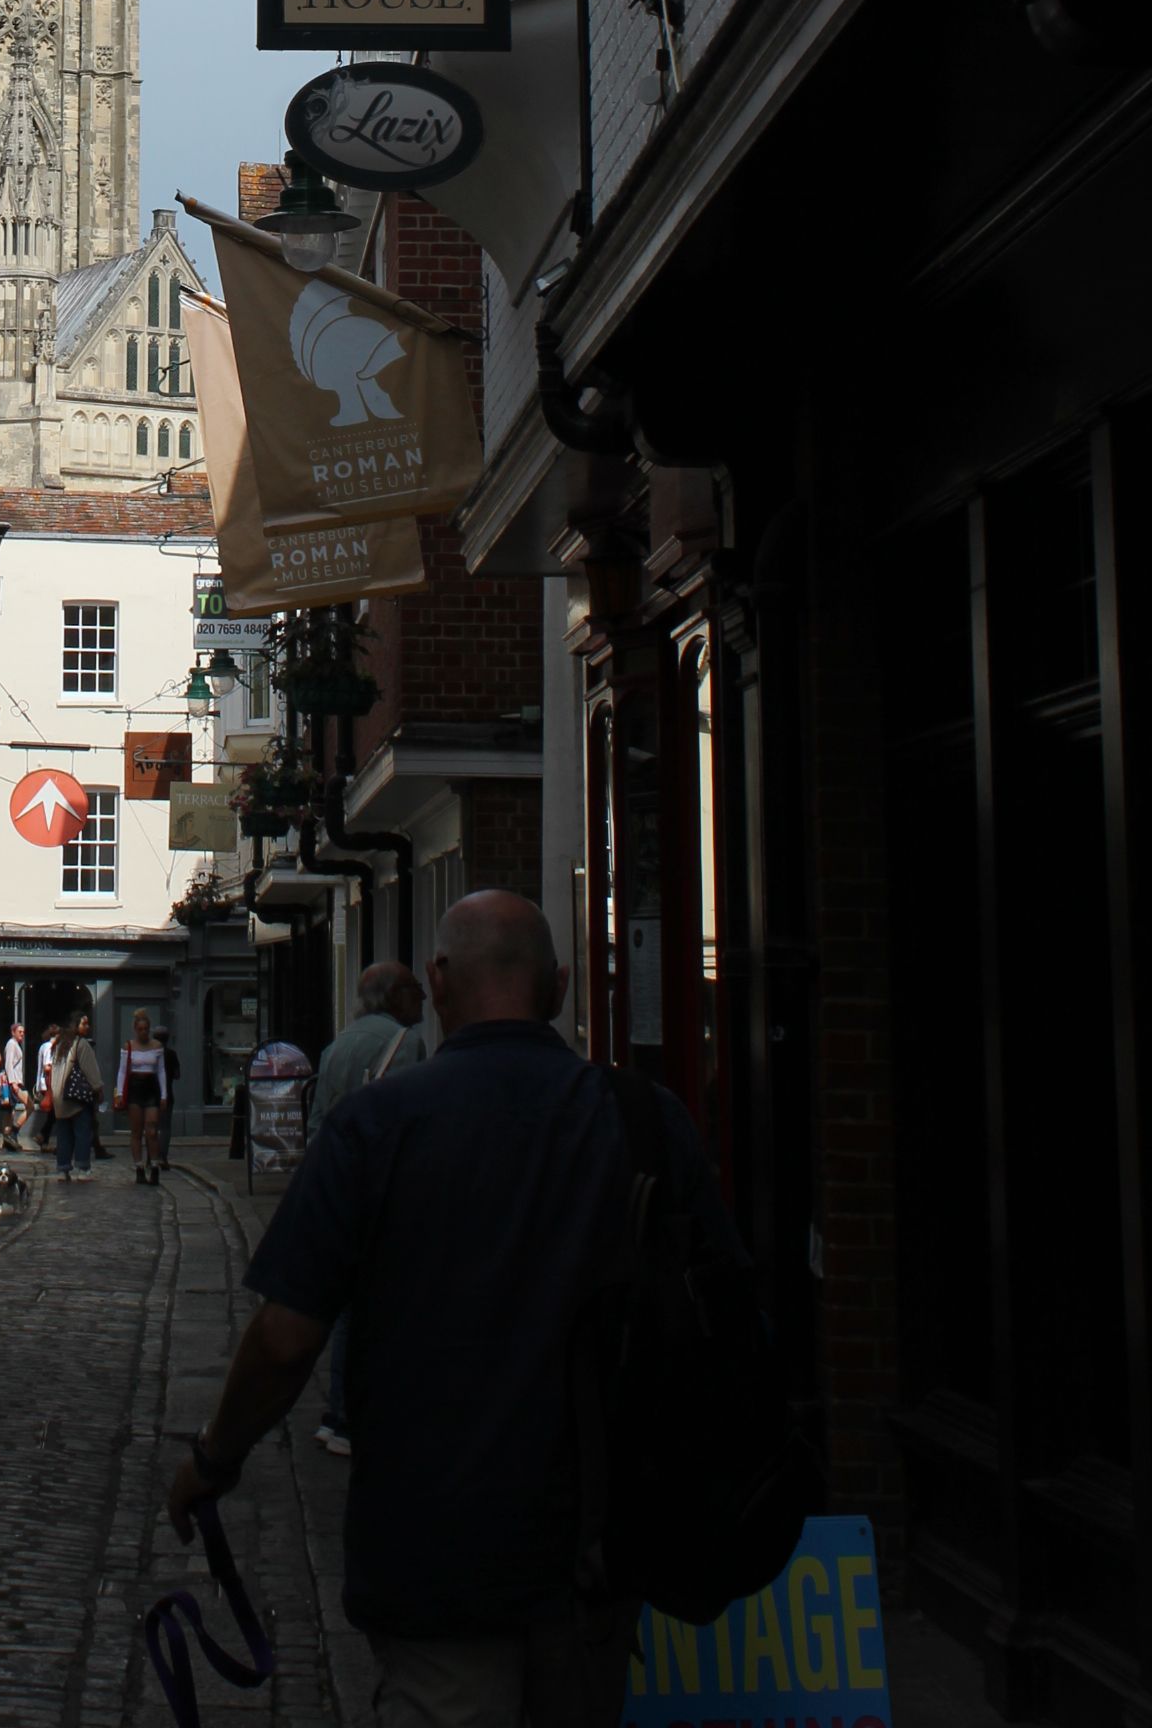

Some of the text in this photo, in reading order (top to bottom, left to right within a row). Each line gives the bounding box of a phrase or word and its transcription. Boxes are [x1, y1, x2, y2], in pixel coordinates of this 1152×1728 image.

[309, 432, 420, 461] CANTERBURY
[312, 447, 423, 483] ROMAN
[326, 471, 417, 497] MUSEUM
[268, 526, 366, 550] CANTERBURY
[271, 539, 368, 569] ROMAN
[282, 561, 362, 584] MUSEUM
[197, 593, 223, 614] TO
[197, 623, 269, 634] 020 7659 4848
